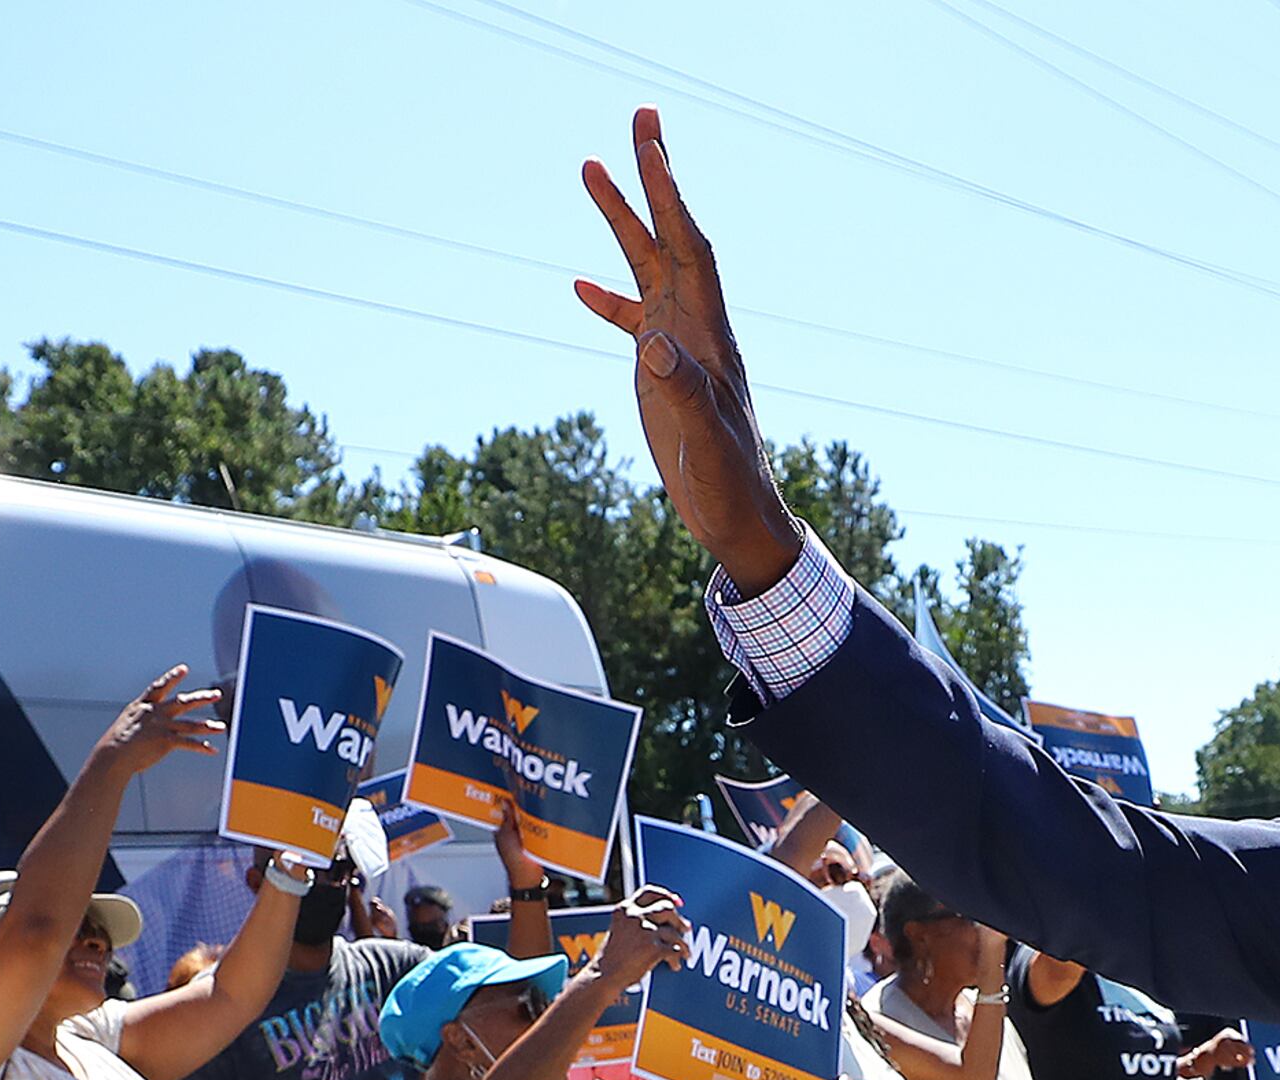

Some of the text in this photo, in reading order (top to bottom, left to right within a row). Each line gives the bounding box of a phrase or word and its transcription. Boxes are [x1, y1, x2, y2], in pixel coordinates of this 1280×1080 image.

[686, 926, 830, 1031] Warnock
[755, 1006, 801, 1038] SENATE
[691, 1038, 717, 1065] Text
[1120, 1053, 1177, 1077] VOT
